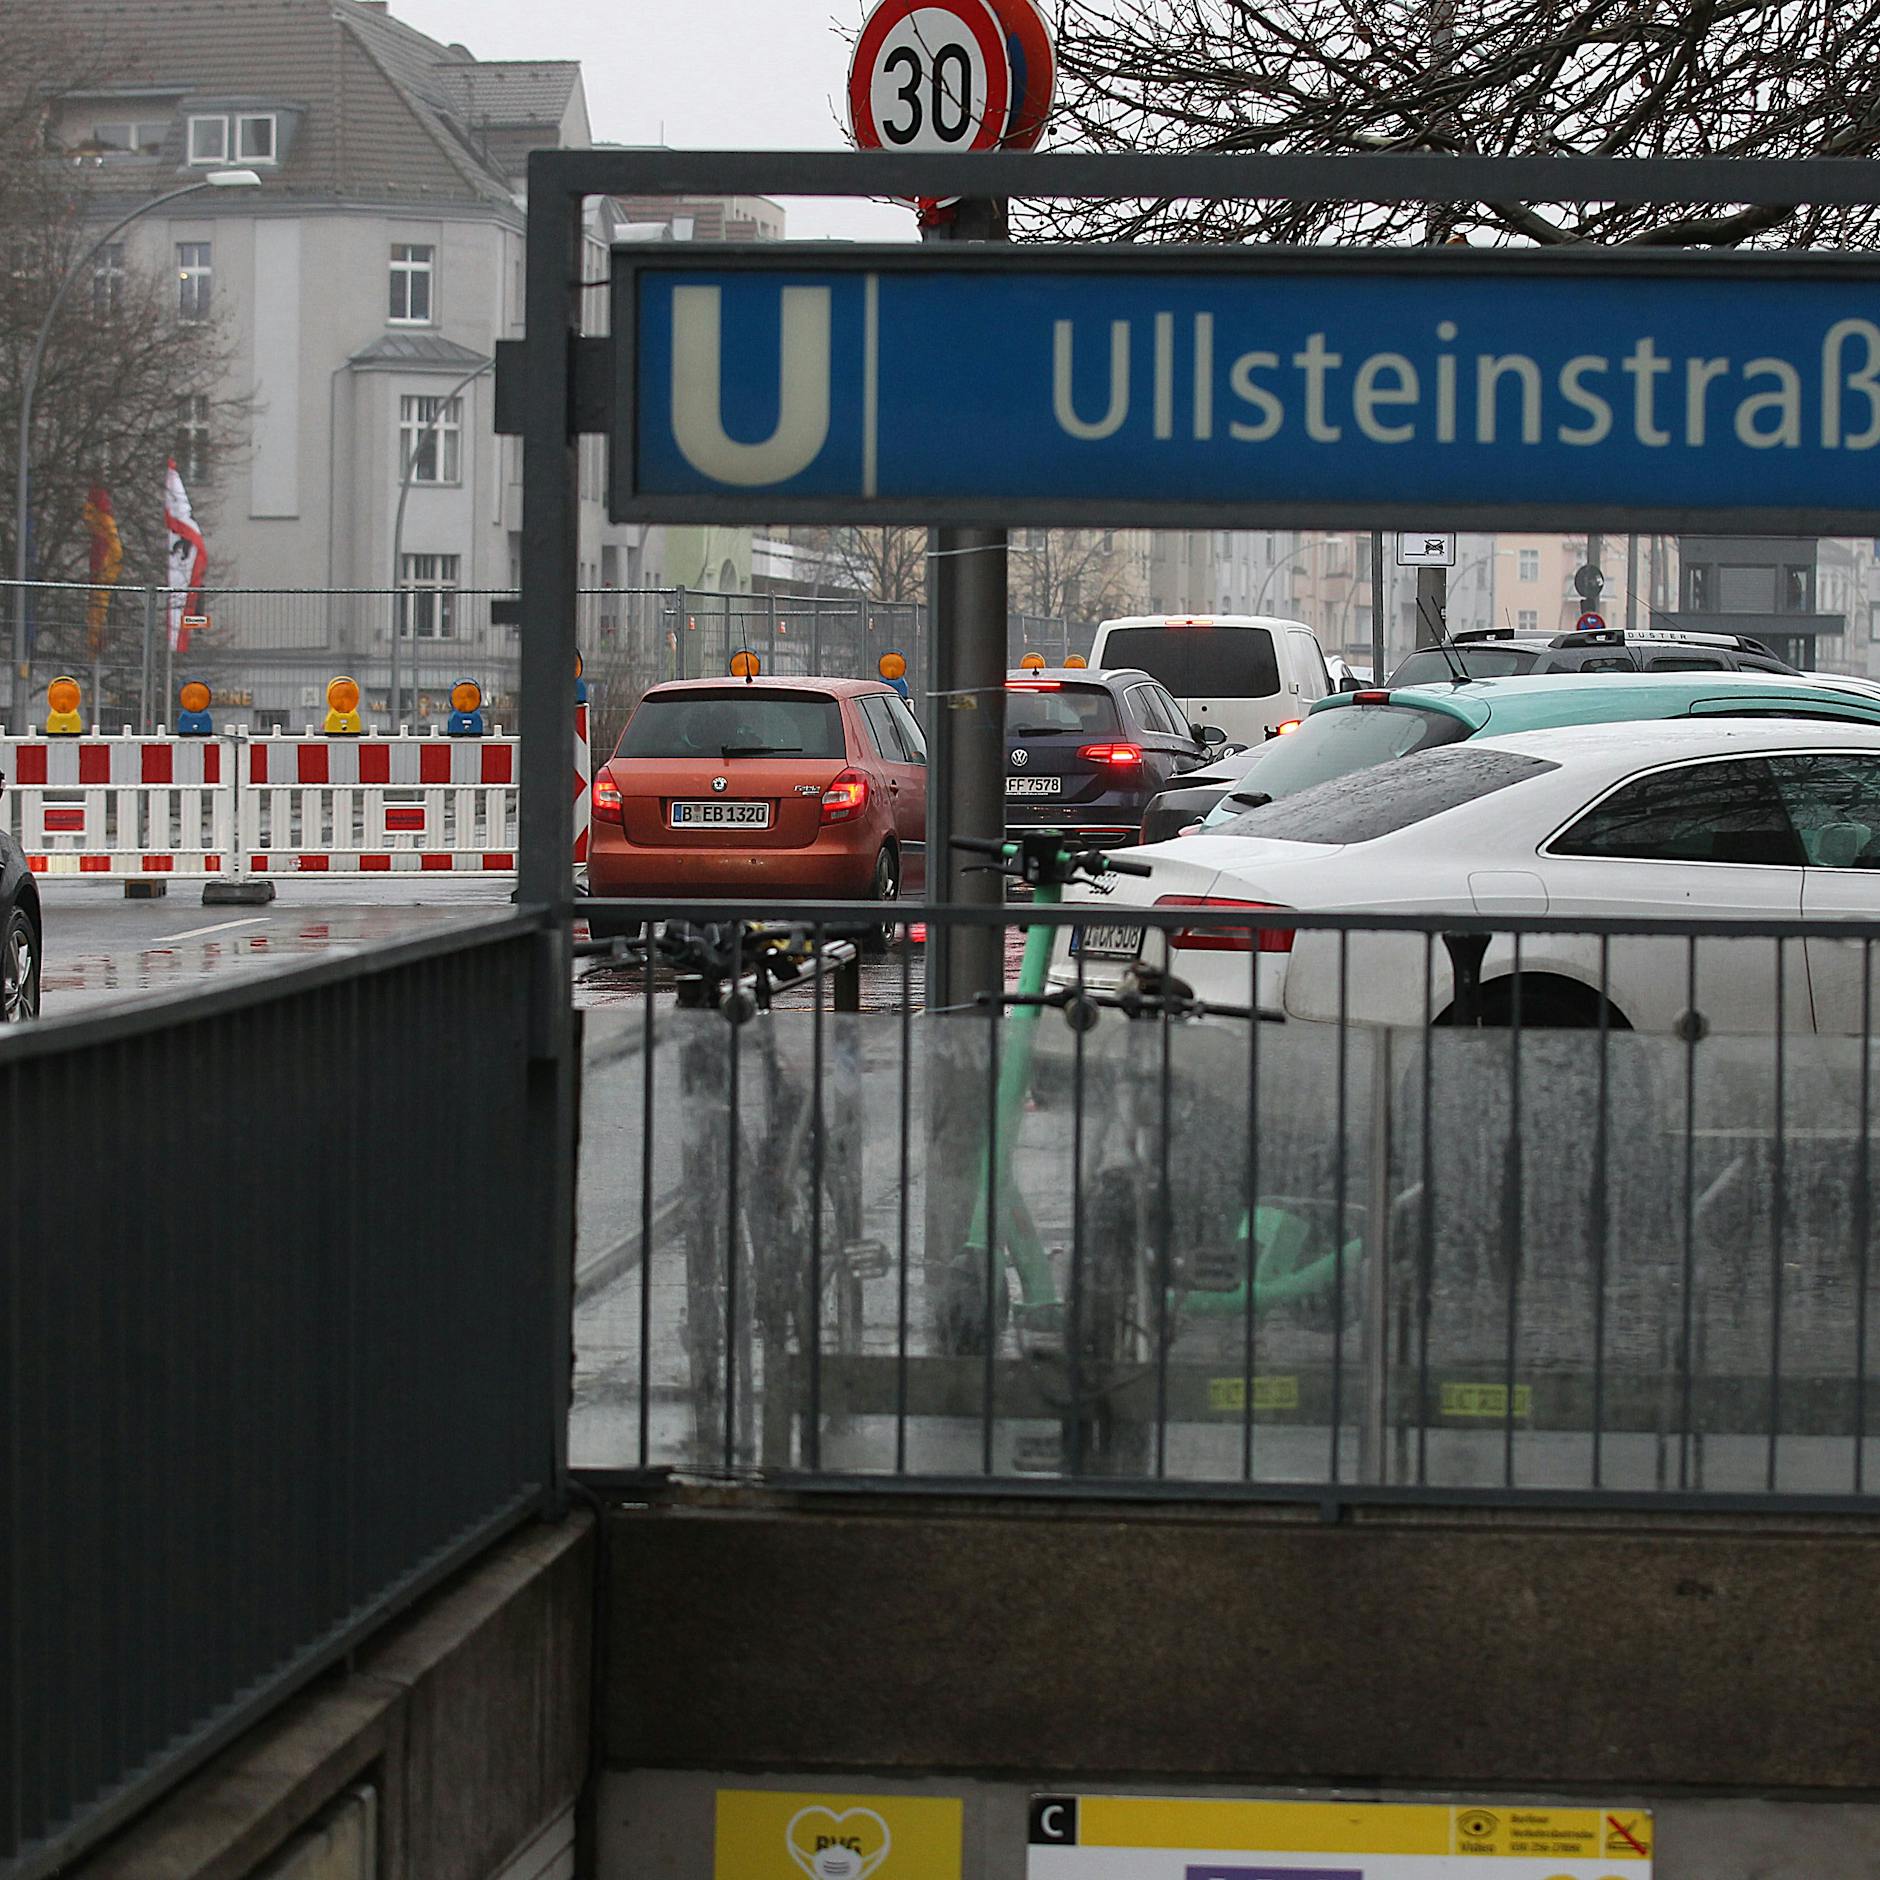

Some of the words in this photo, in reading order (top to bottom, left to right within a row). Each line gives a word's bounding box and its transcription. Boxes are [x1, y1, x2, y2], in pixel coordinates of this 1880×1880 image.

[882, 43, 972, 145] 30
[670, 285, 832, 486] U
[1052, 312, 1880, 450] Ullsteinstraß
[1627, 632, 1688, 640] DUSTER
[1008, 779, 1025, 791] FF
[1027, 779, 1059, 791] 7578
[682, 806, 692, 822] B
[703, 806, 723, 822] EB
[726, 807, 765, 823] 1320
[1040, 1804, 1065, 1838] C
